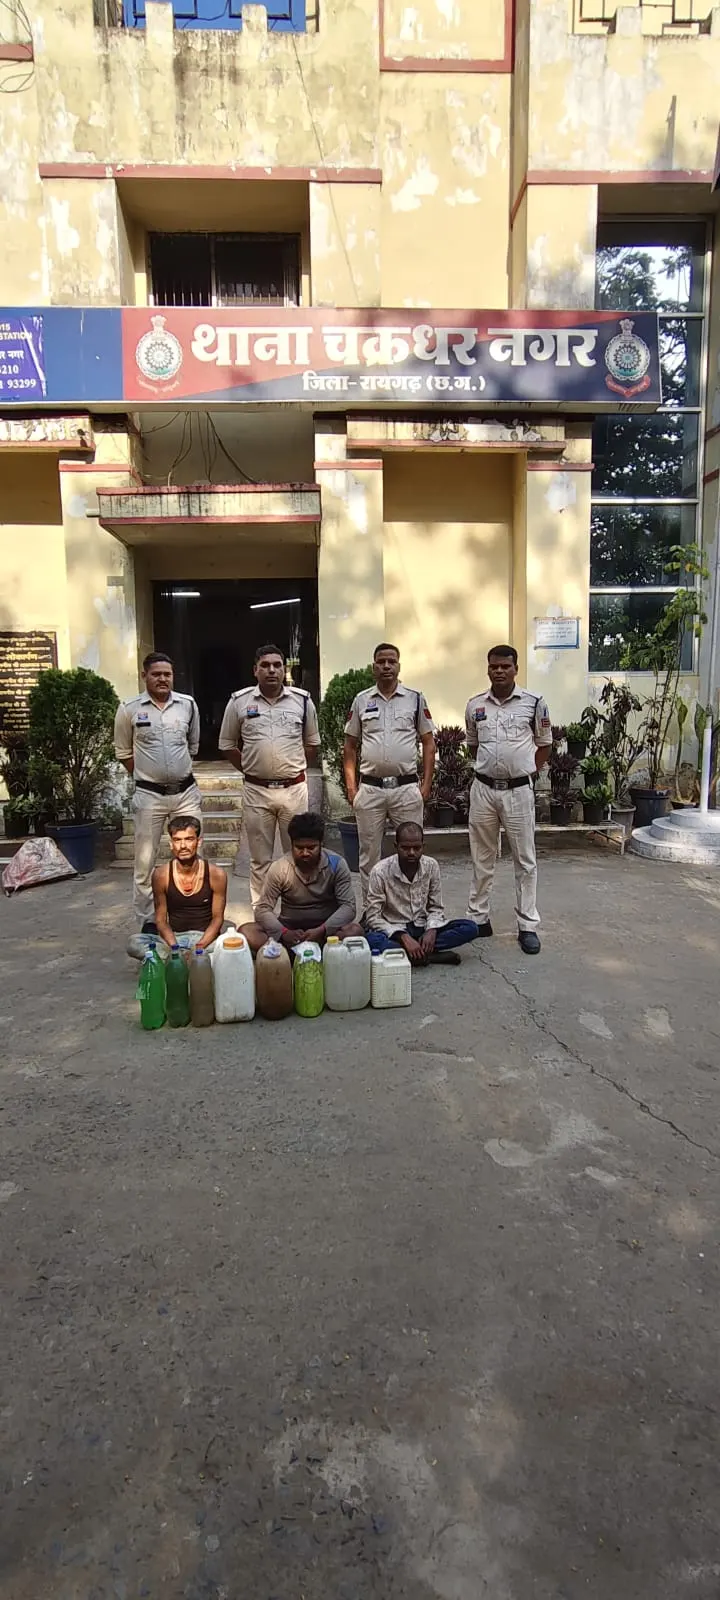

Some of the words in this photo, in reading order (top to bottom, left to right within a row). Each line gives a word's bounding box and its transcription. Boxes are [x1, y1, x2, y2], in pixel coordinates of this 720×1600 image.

[0, 323, 11, 331] 15
[191, 324, 313, 366] थाना
[321, 324, 478, 367] चक्रधर
[488, 327, 598, 367] नगर
[7, 350, 24, 359] नगर
[0, 365, 19, 374] 210
[7, 379, 36, 389] 93299
[425, 375, 486, 391] (छ.ग.)
